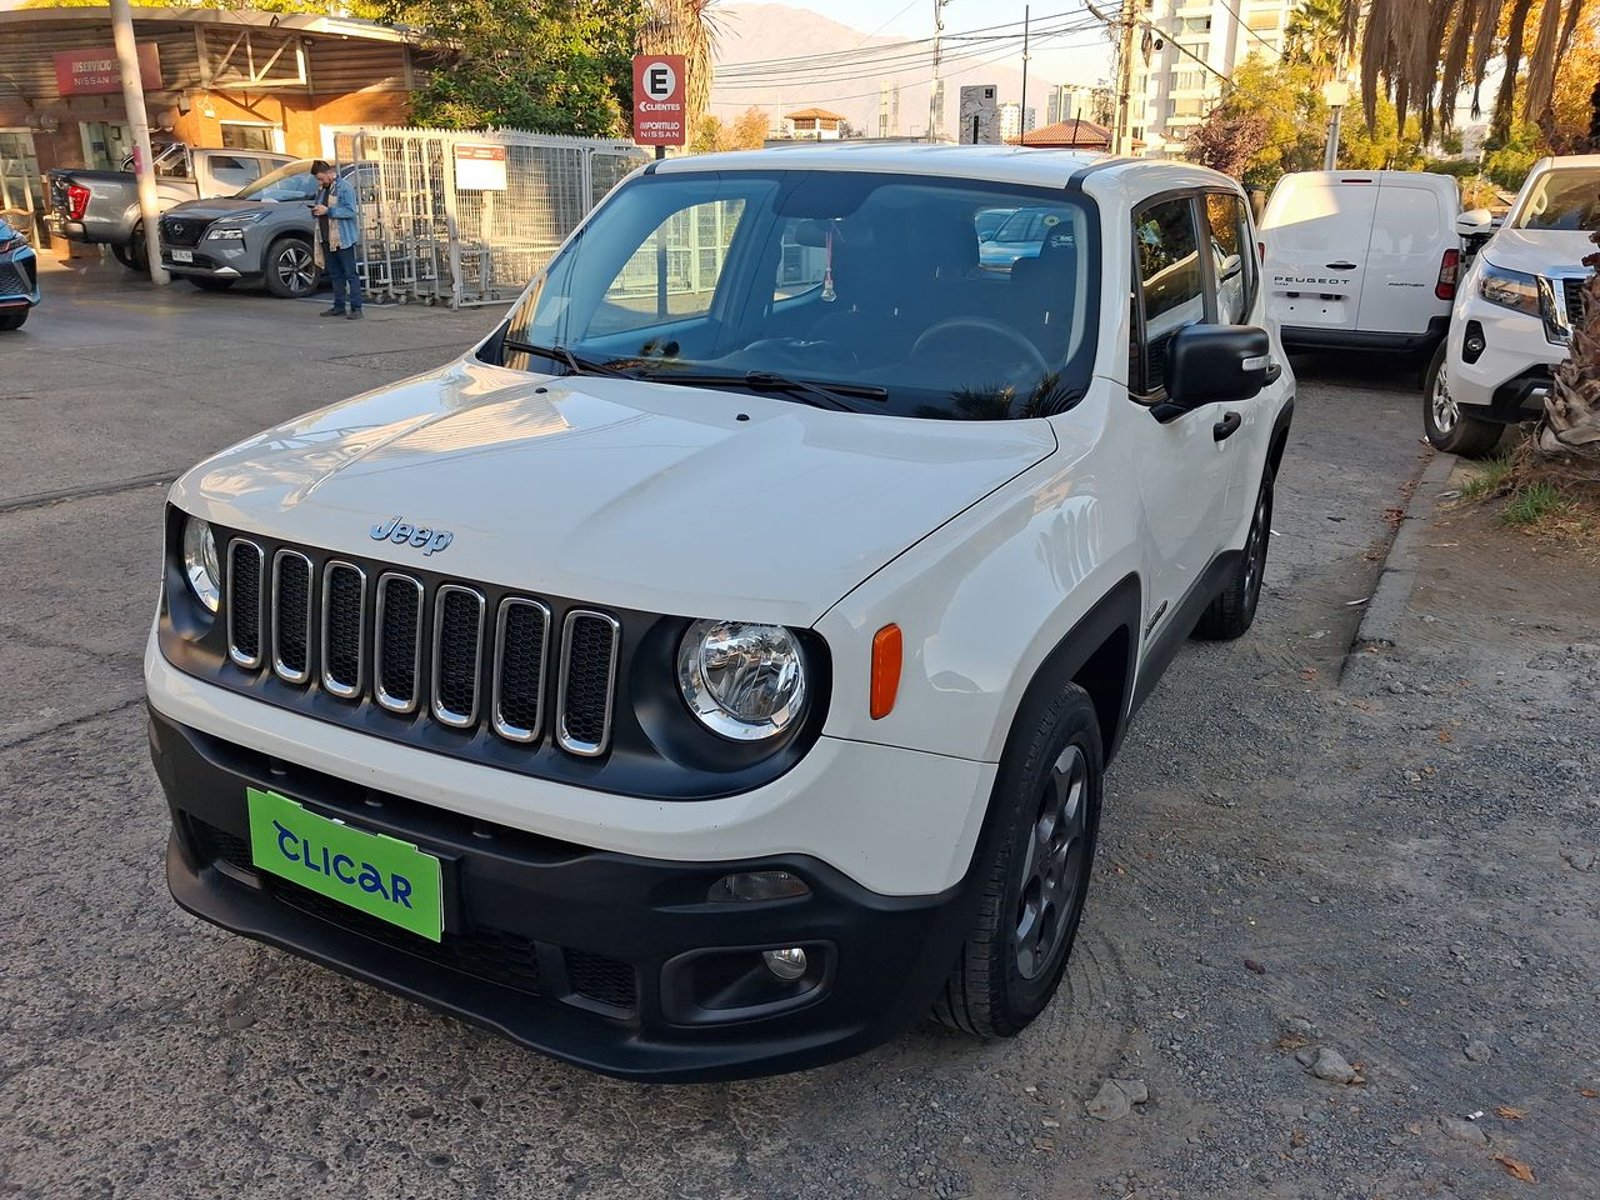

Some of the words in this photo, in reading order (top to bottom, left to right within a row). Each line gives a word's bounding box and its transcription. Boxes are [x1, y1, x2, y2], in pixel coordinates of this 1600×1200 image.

[74, 76, 110, 86] NISSAN
[650, 69, 668, 94] E
[645, 103, 680, 111] CLIENTES
[645, 121, 680, 130] PORTILLO
[640, 130, 680, 138] NISSAN
[1274, 276, 1350, 285] PEUGEOT
[370, 515, 454, 557] Jeep
